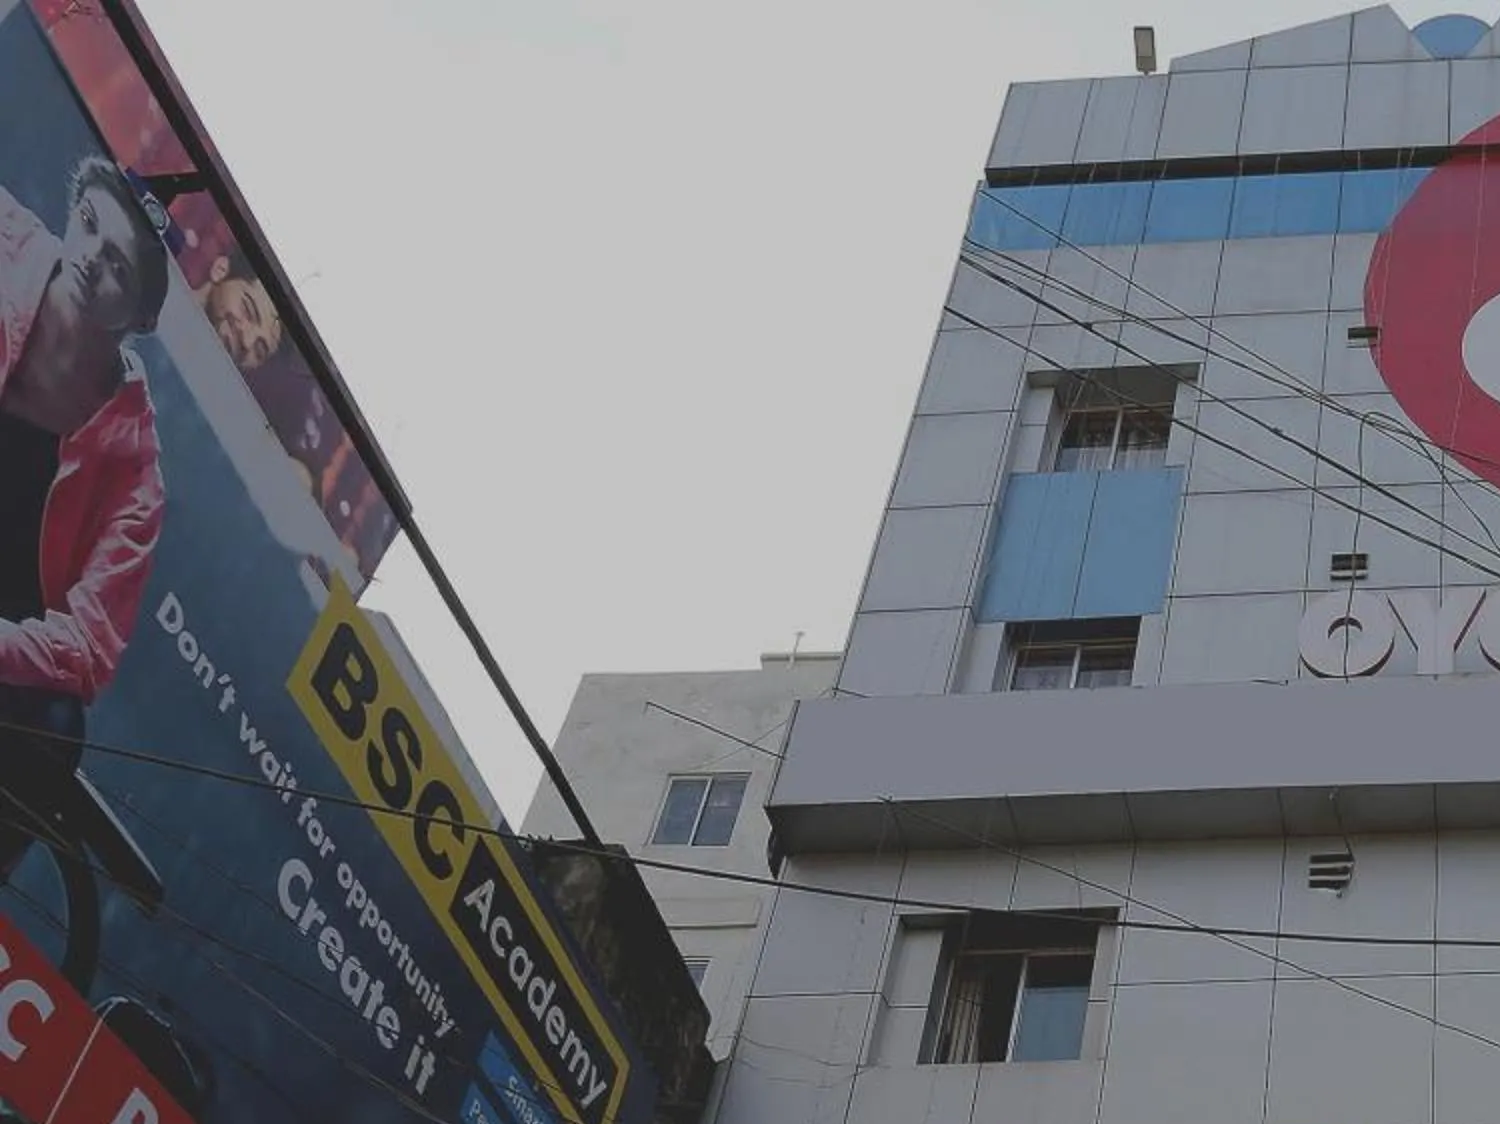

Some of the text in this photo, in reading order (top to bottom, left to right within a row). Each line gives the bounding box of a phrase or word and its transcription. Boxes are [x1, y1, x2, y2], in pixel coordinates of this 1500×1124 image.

[154, 591, 458, 1039] Don't wait for opportunity
[311, 622, 465, 881] BSC
[277, 857, 436, 1094] Create it
[463, 878, 608, 1110] Academy
